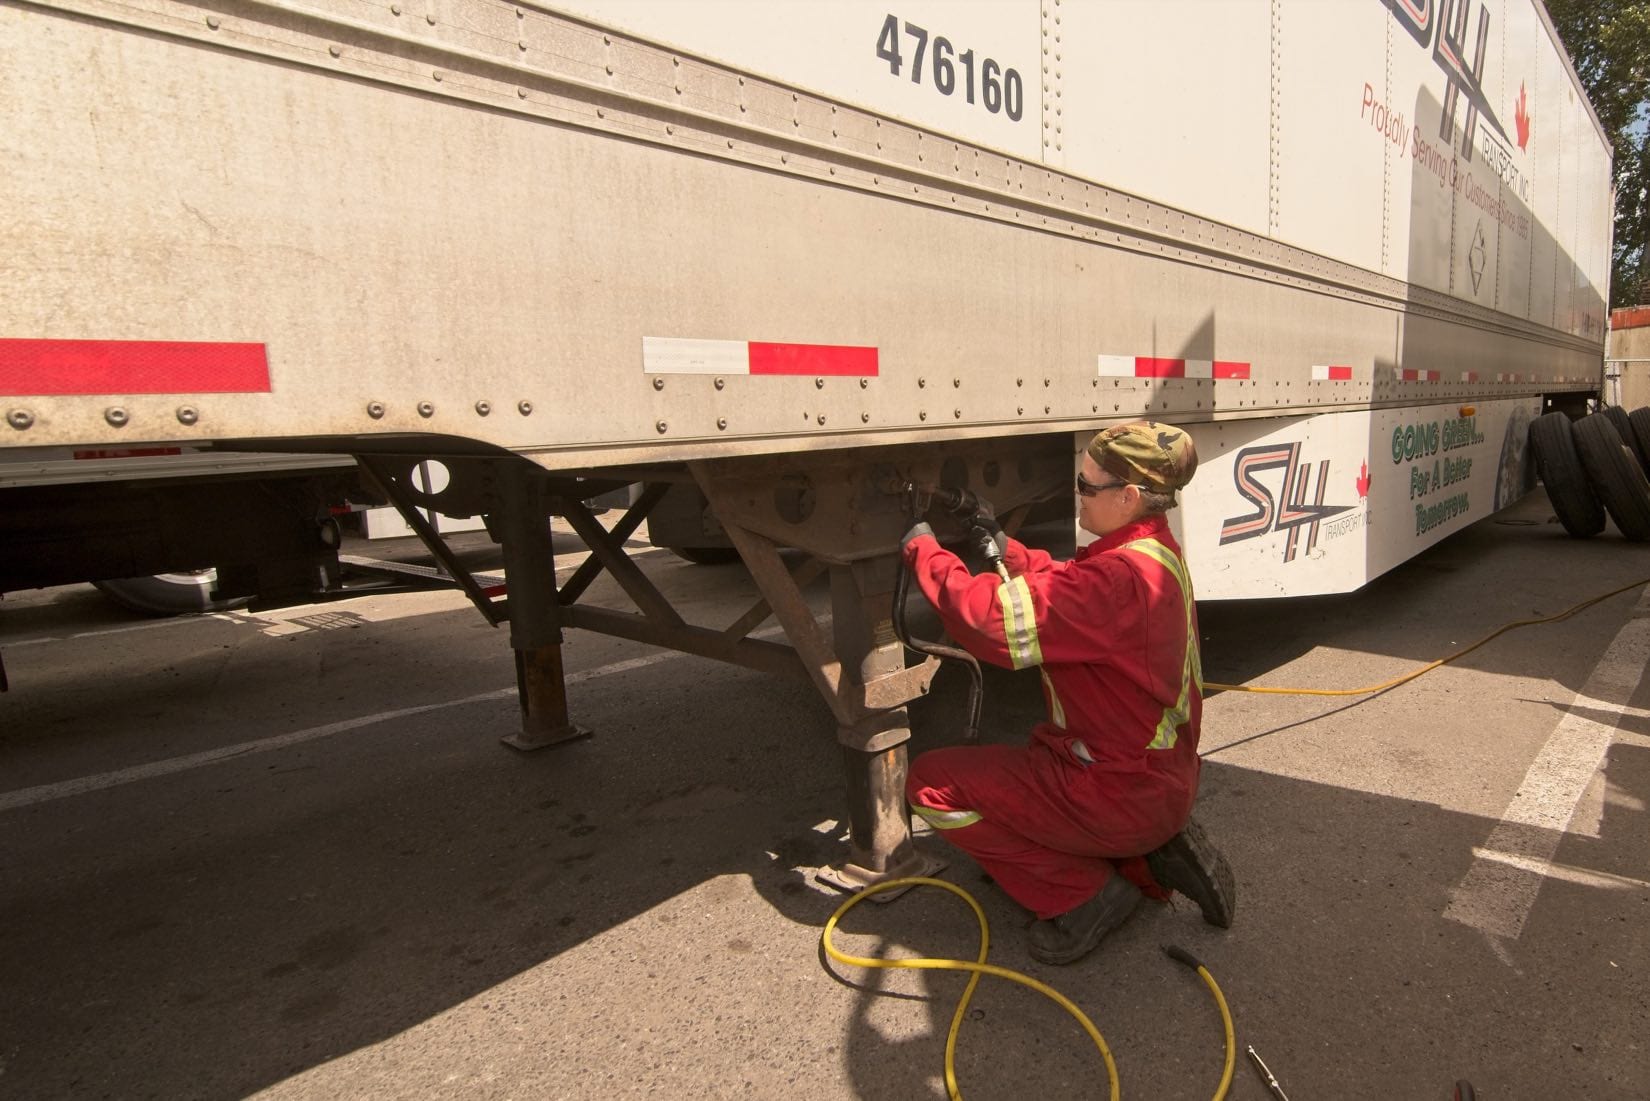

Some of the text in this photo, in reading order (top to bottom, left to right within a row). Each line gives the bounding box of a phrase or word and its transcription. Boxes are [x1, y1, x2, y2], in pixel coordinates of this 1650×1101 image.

[875, 13, 1023, 122] 476160
[1361, 81, 1409, 158] Proudly
[1411, 125, 1447, 189] Serving
[1449, 159, 1465, 193] Our
[1465, 172, 1502, 221] Customers
[1480, 123, 1519, 192] TRANSPORT
[1391, 421, 1440, 465] GOING
[1409, 455, 1473, 501] For A Better
[1323, 513, 1362, 542] TRANSPORT
